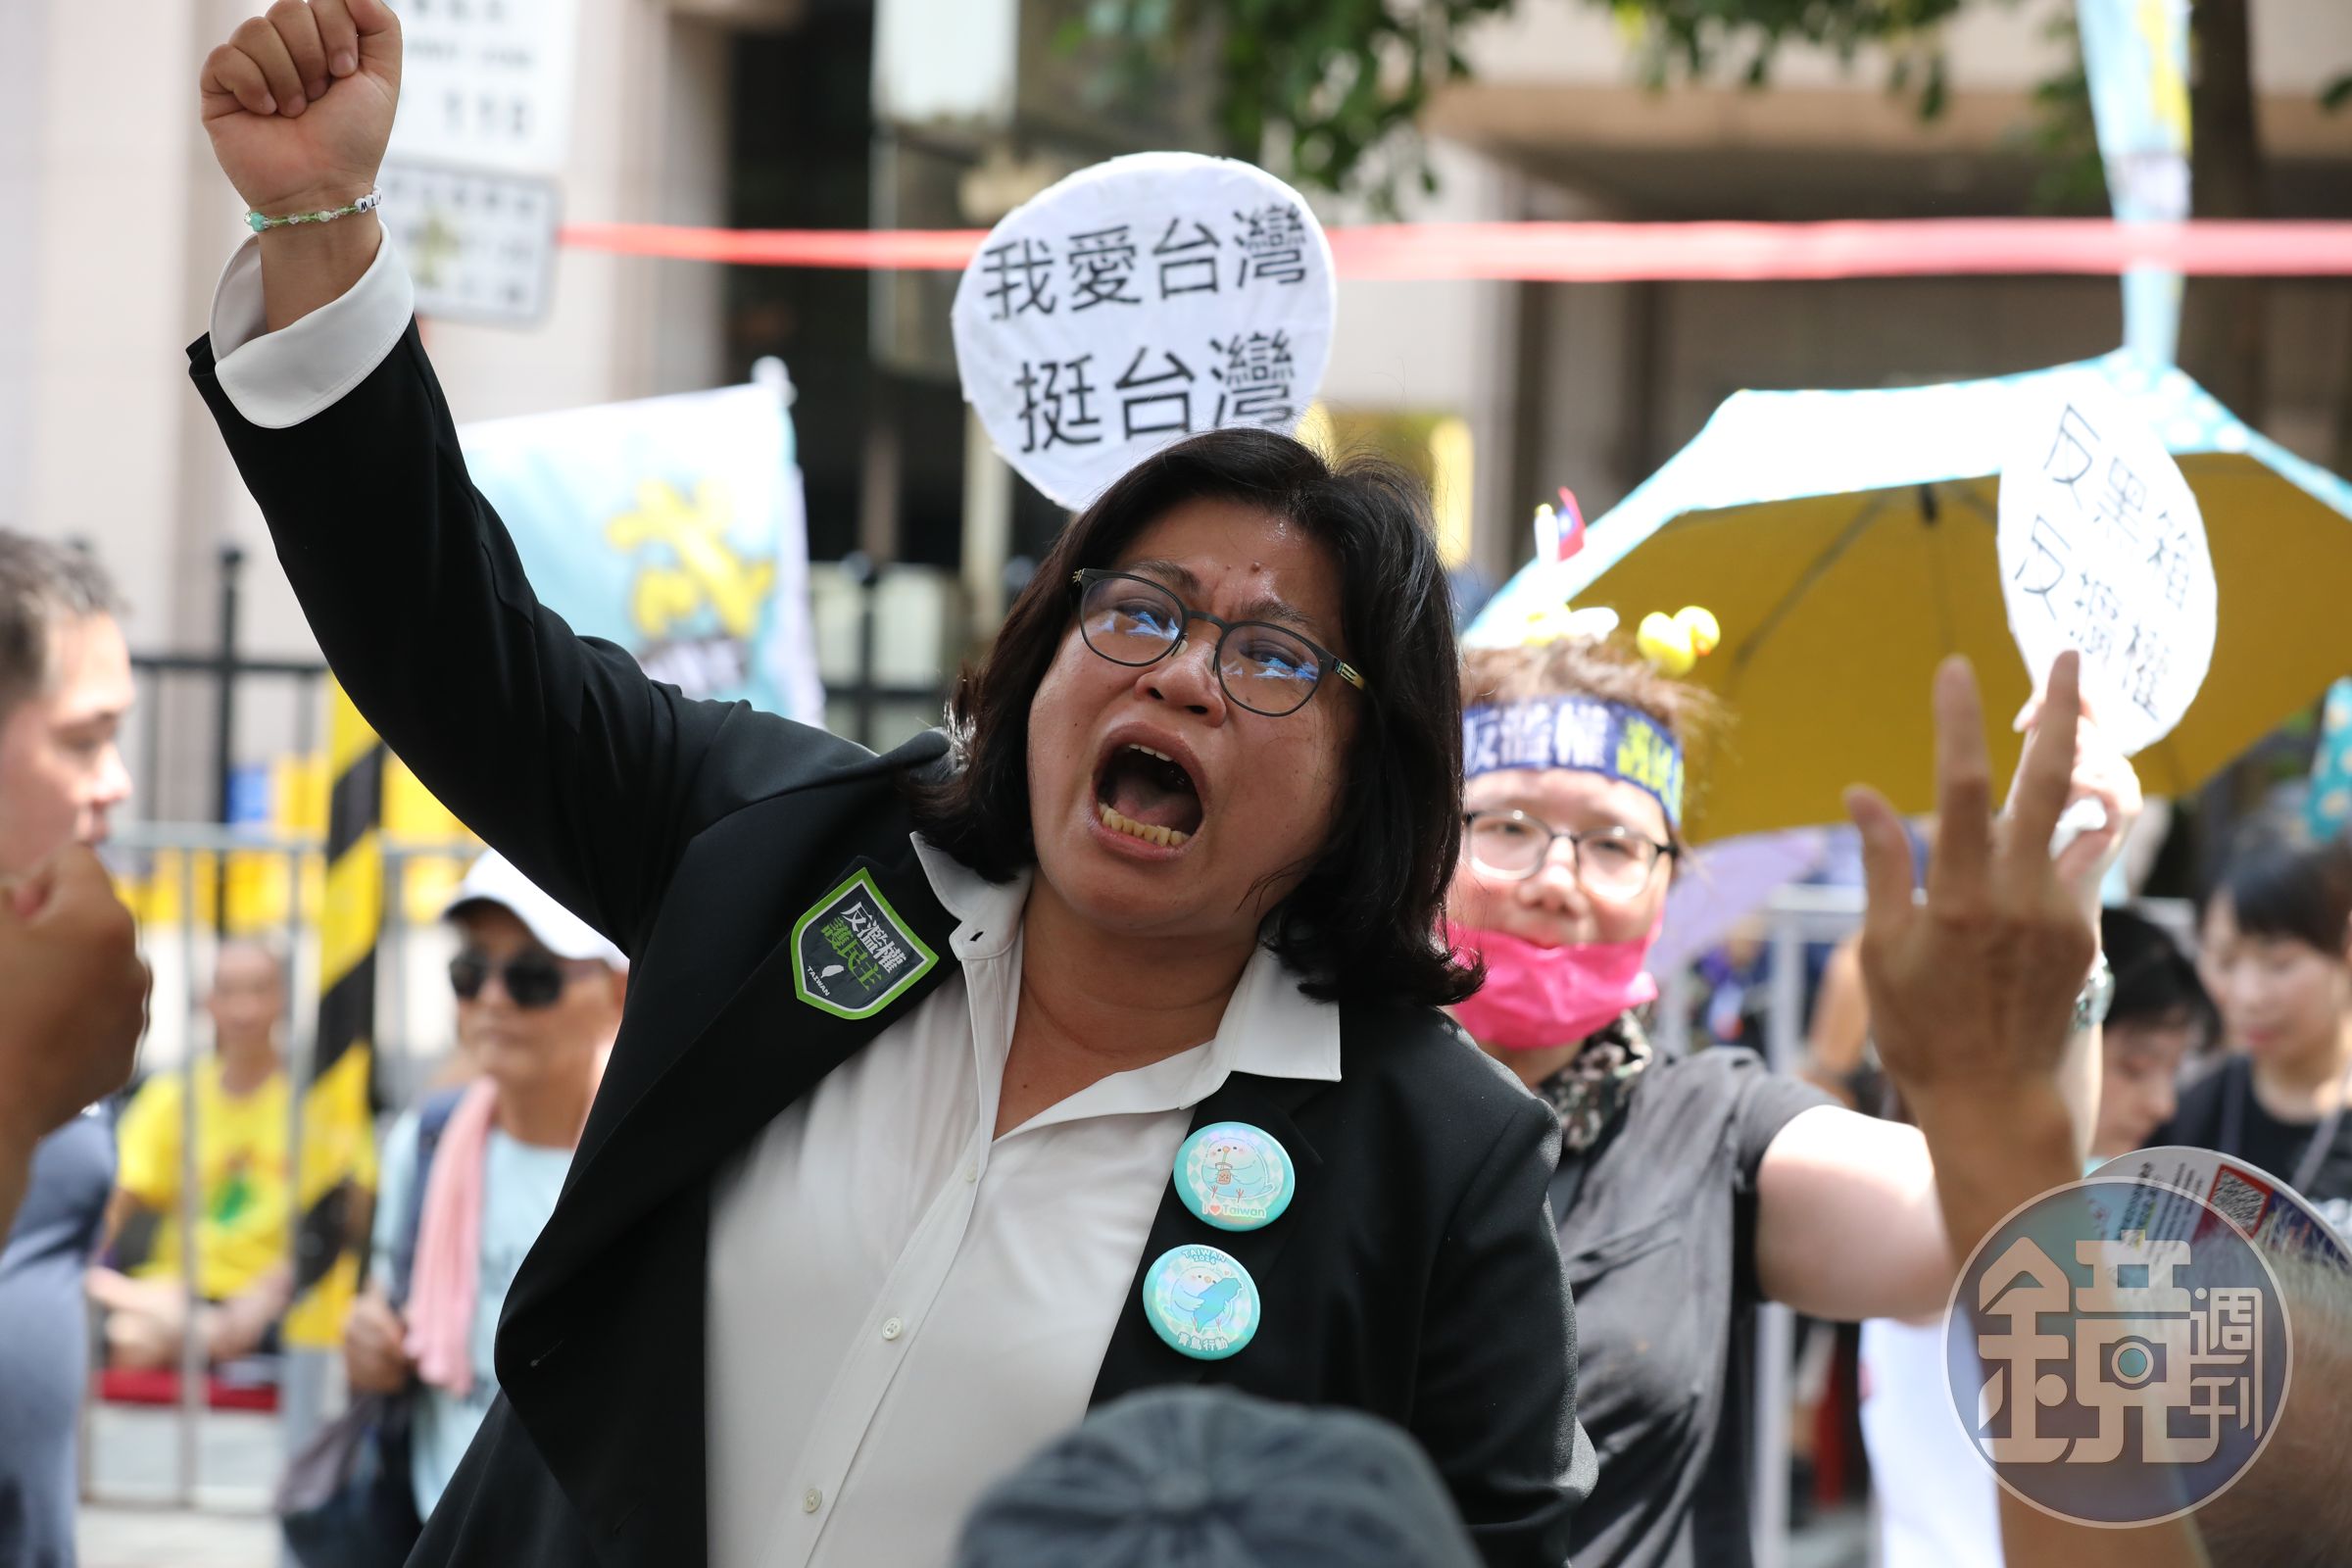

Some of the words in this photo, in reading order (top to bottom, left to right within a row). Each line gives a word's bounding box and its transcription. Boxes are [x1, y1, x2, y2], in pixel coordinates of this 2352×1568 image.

[982, 201, 1307, 321] 我愛台灣
[1013, 329, 1298, 455] 挺台灣
[840, 901, 907, 974] 反濫權
[807, 965, 831, 997] TAIWAN
[1223, 1203, 1266, 1217] Taiwan
[1182, 1248, 1227, 1263] TAIWAN
